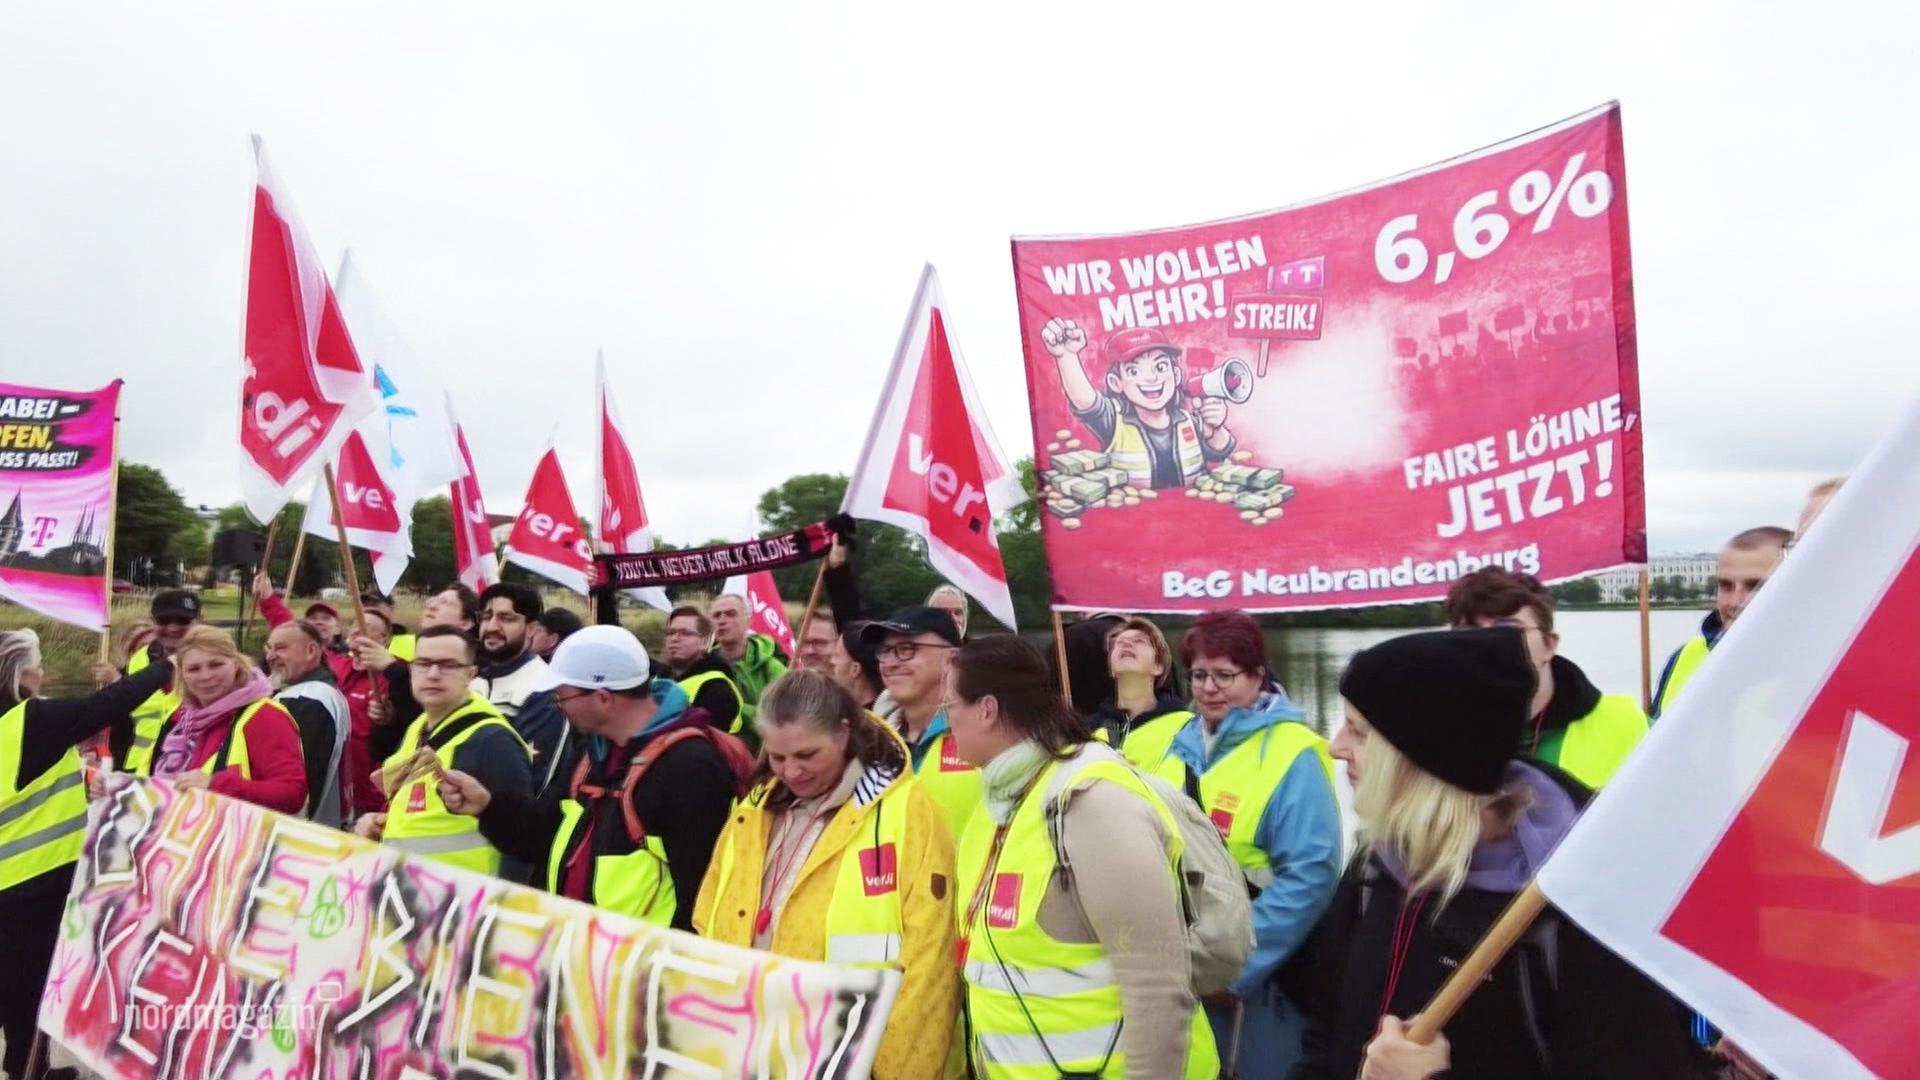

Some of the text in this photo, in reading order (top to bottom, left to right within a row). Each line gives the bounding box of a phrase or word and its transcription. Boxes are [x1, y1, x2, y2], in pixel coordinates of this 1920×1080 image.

[1374, 150, 1613, 285] 6,6%
[1041, 234, 1267, 296] WIR WOLLEN
[1098, 278, 1228, 332] MEHR!
[1233, 302, 1317, 331] STREIK!
[0, 424, 53, 452] FEN,
[1402, 392, 1639, 490] FAIRE LÖHNE,
[1436, 440, 1614, 538] JETZT!
[659, 554, 706, 578] NEVER
[706, 545, 749, 572] WALK
[747, 533, 800, 564] ALONE
[1162, 542, 1541, 599] BeG Neubrandenburg
